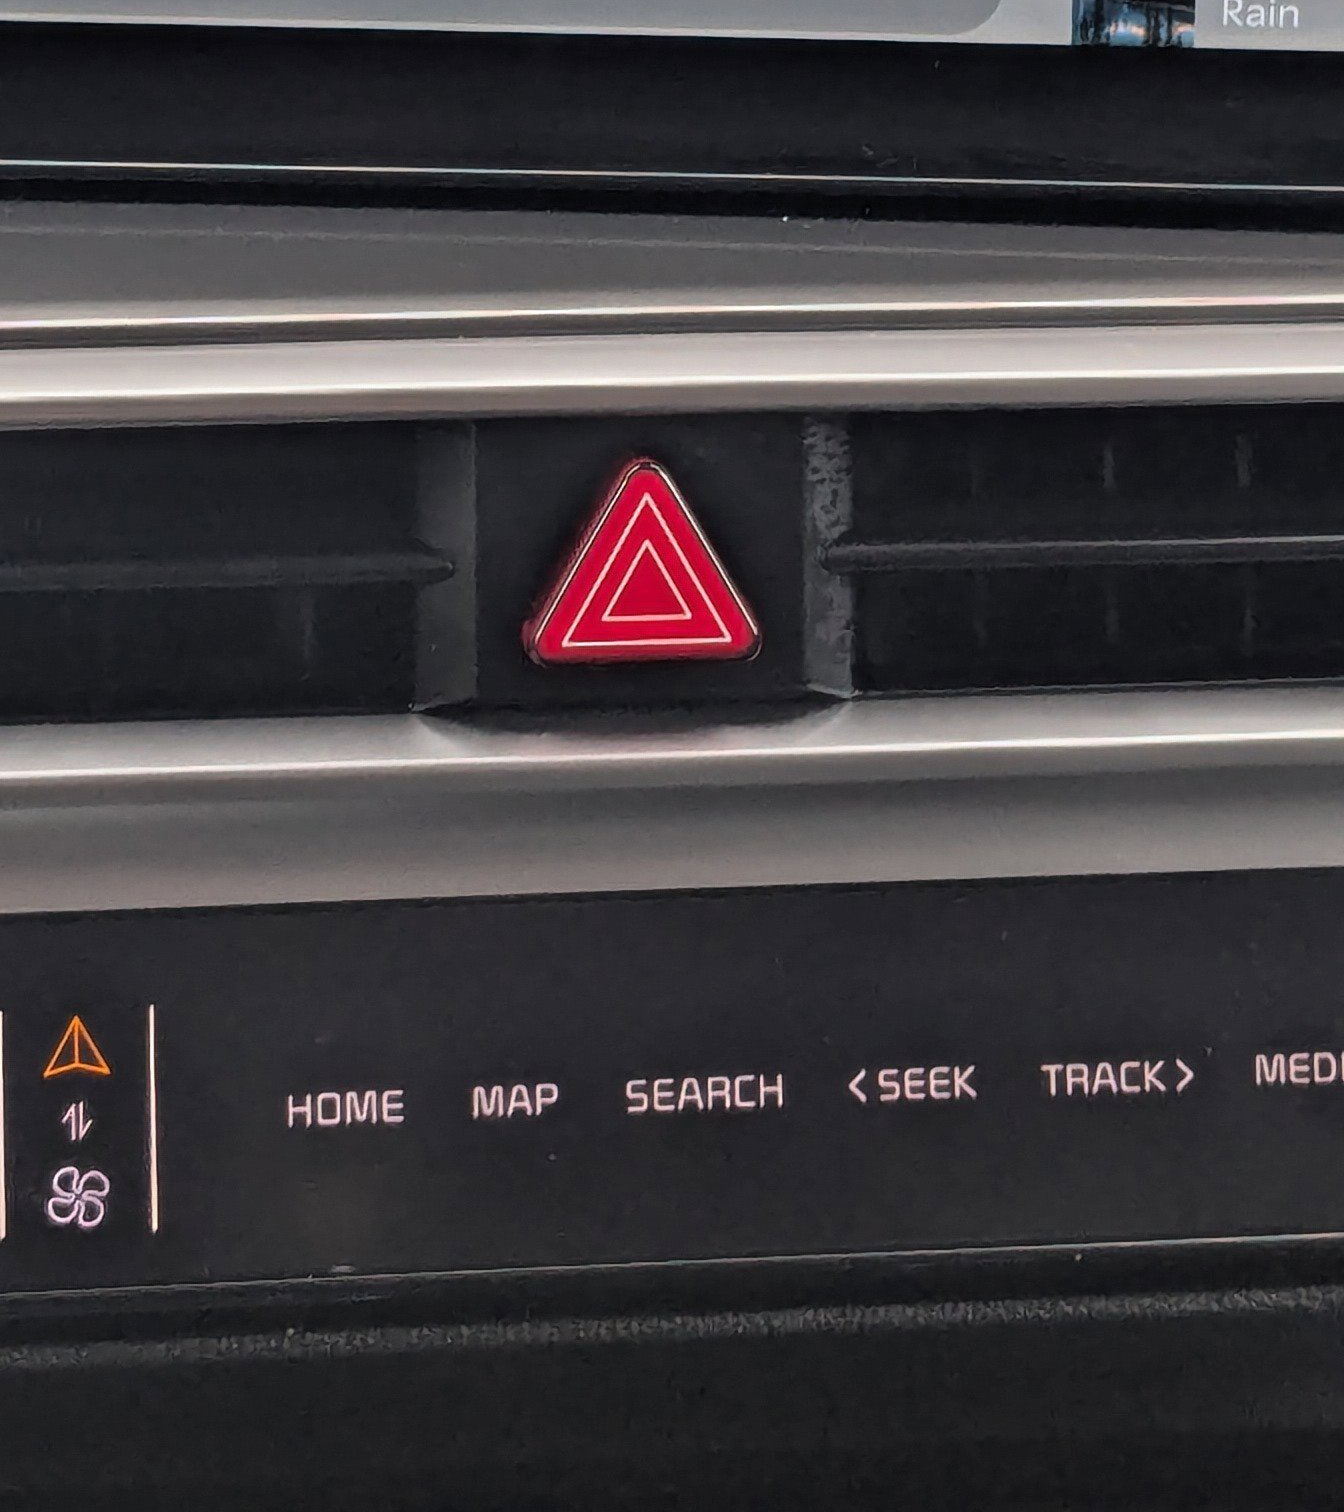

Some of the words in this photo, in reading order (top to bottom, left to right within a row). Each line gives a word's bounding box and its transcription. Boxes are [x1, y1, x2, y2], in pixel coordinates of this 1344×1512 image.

[287, 1089, 404, 1128] HOME
[472, 1083, 559, 1118] MAP
[625, 1073, 783, 1113] SEARCH
